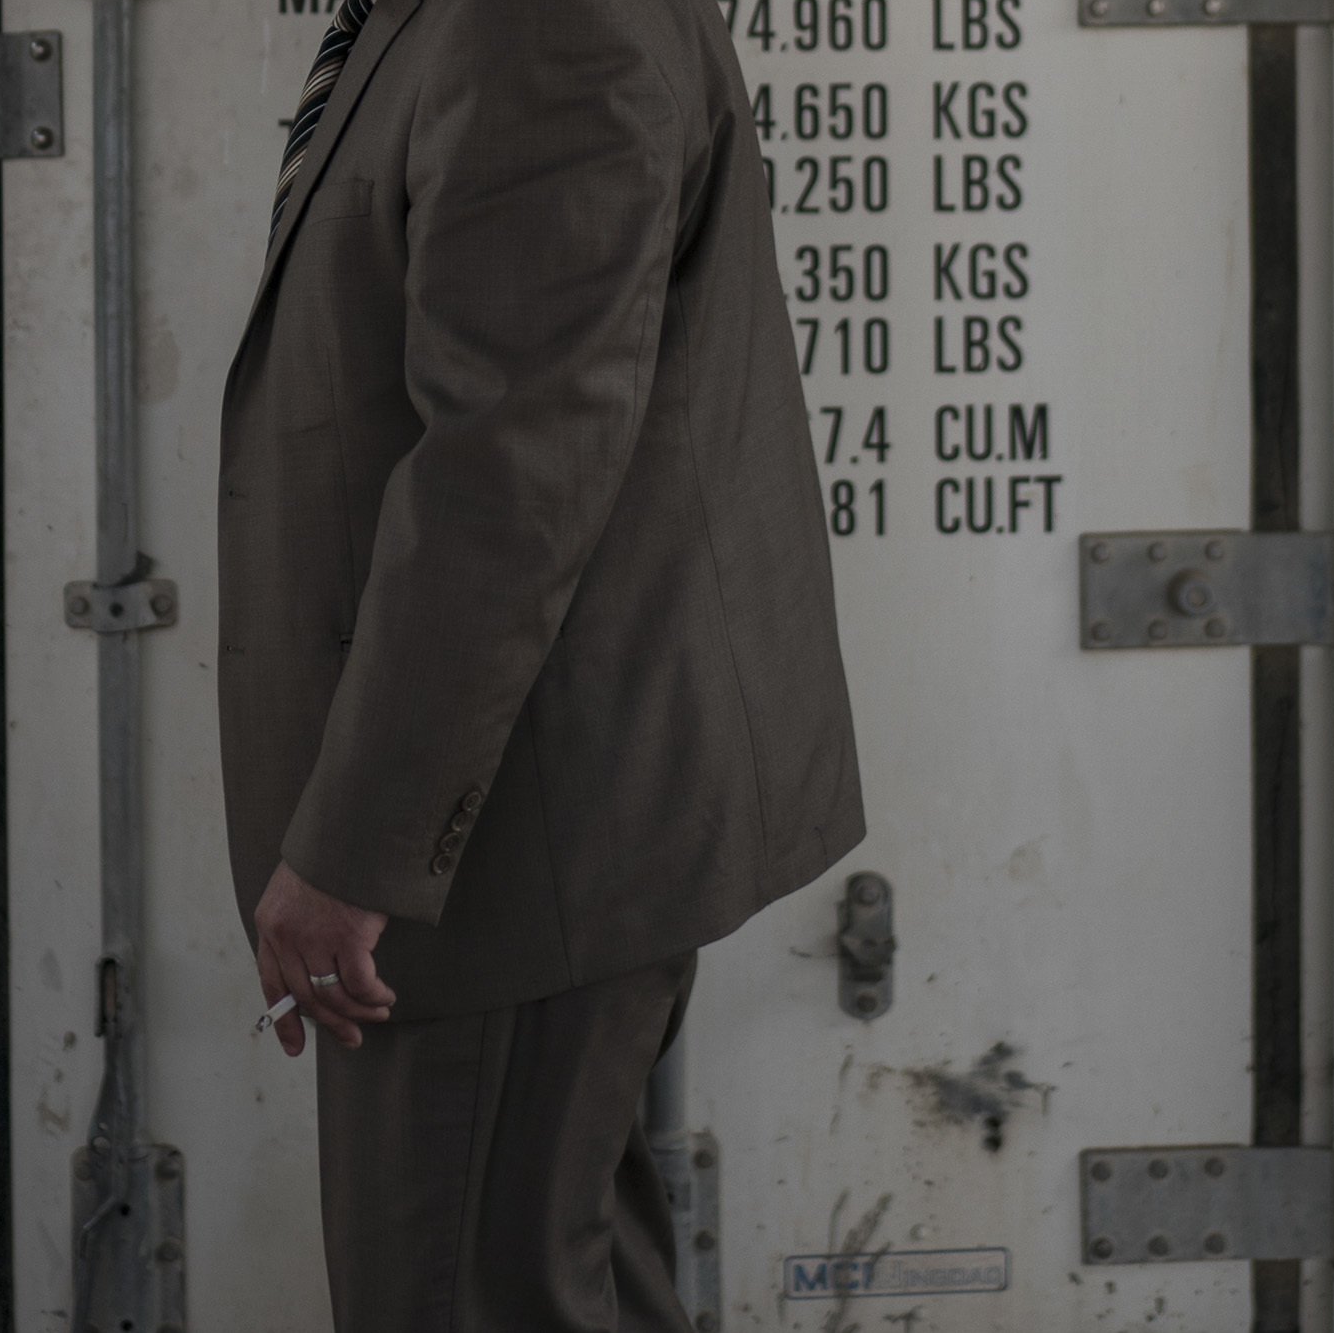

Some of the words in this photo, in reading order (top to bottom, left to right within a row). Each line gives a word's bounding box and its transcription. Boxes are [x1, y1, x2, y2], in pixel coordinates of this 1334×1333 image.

[933, 81, 1029, 140] KGS
[934, 155, 1023, 213] LBS
[934, 243, 1029, 302] KGS
[934, 316, 1024, 375] LBS
[936, 404, 1049, 463] CU.M
[936, 476, 1062, 535] CU.FT
